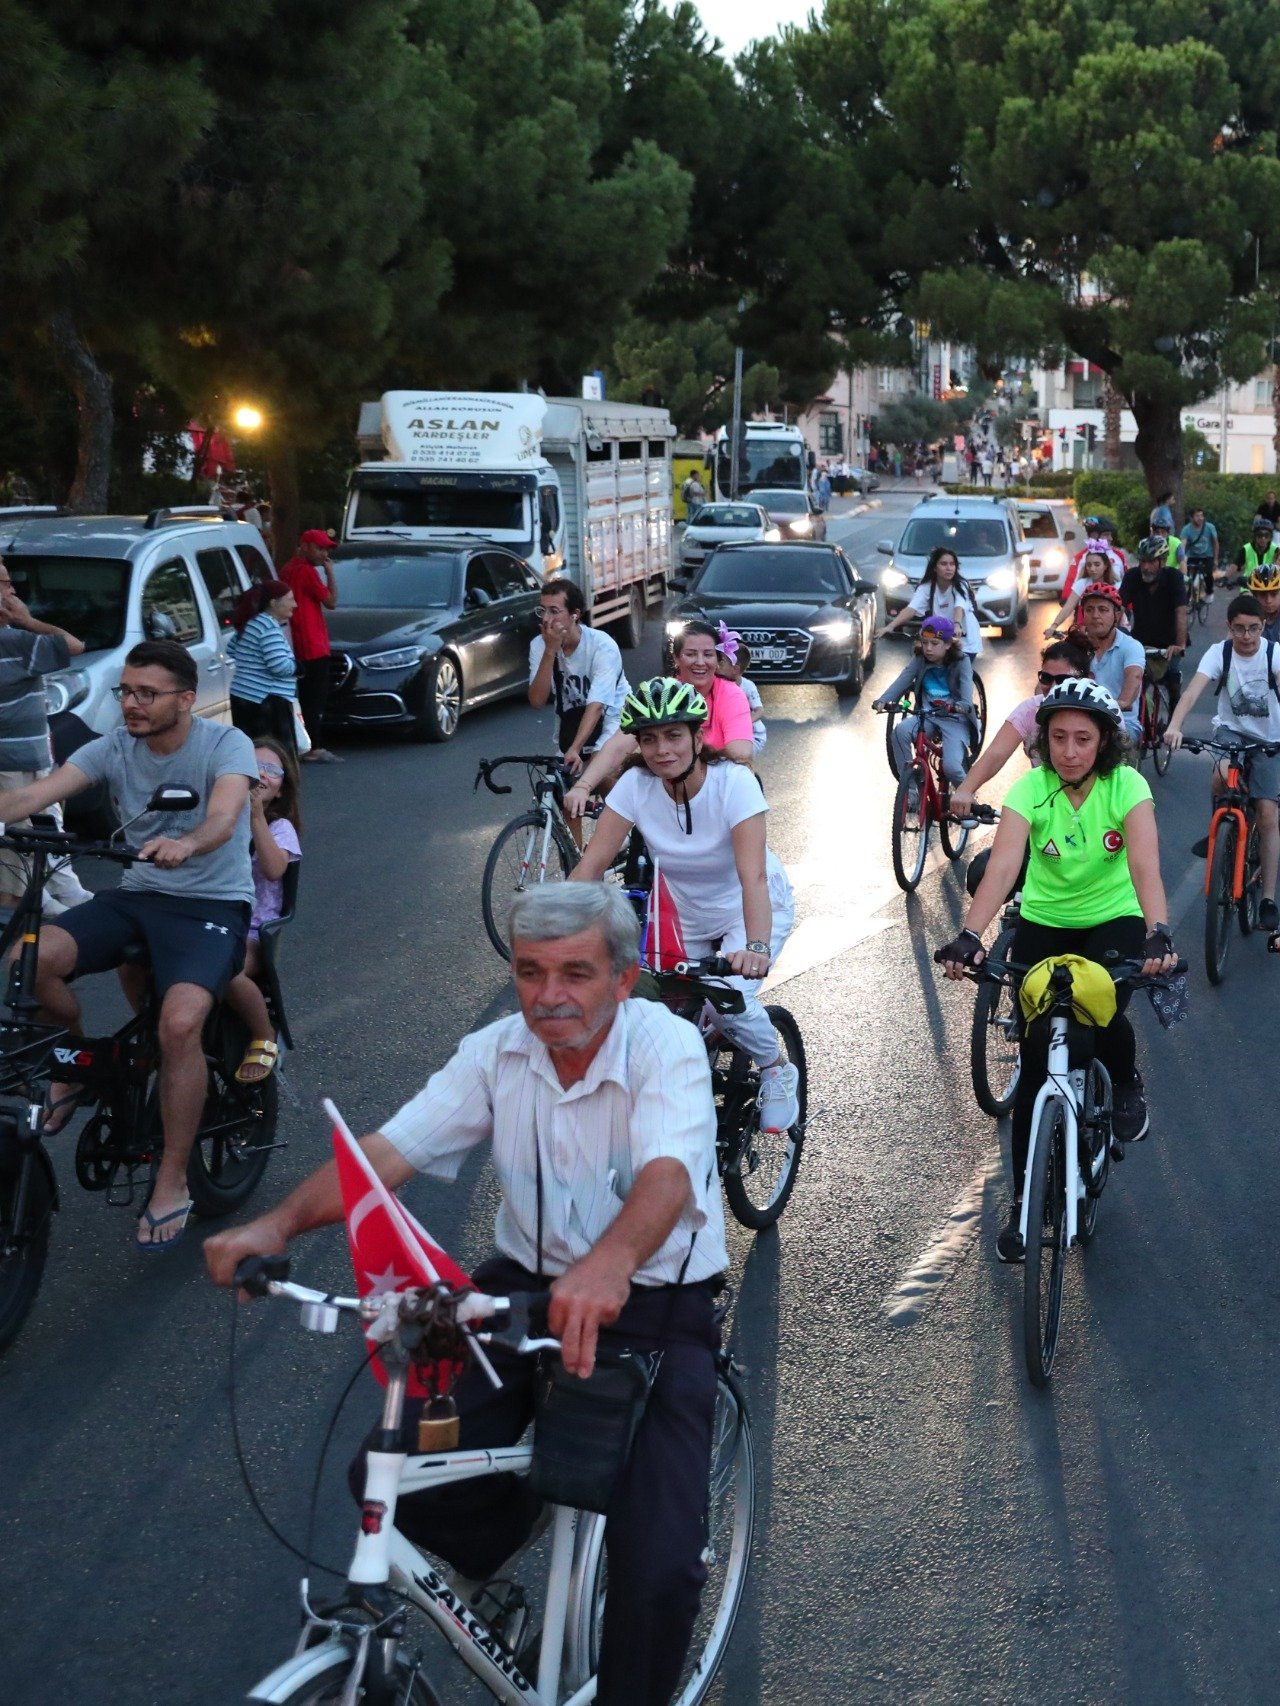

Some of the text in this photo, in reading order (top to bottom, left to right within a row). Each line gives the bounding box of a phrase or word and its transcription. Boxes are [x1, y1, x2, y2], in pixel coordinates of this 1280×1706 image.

[407, 419, 500, 431] ASLAN
[413, 431, 490, 442] KARDEŞLER
[769, 649, 785, 658] 007
[423, 1571, 530, 1692] SALCANO
